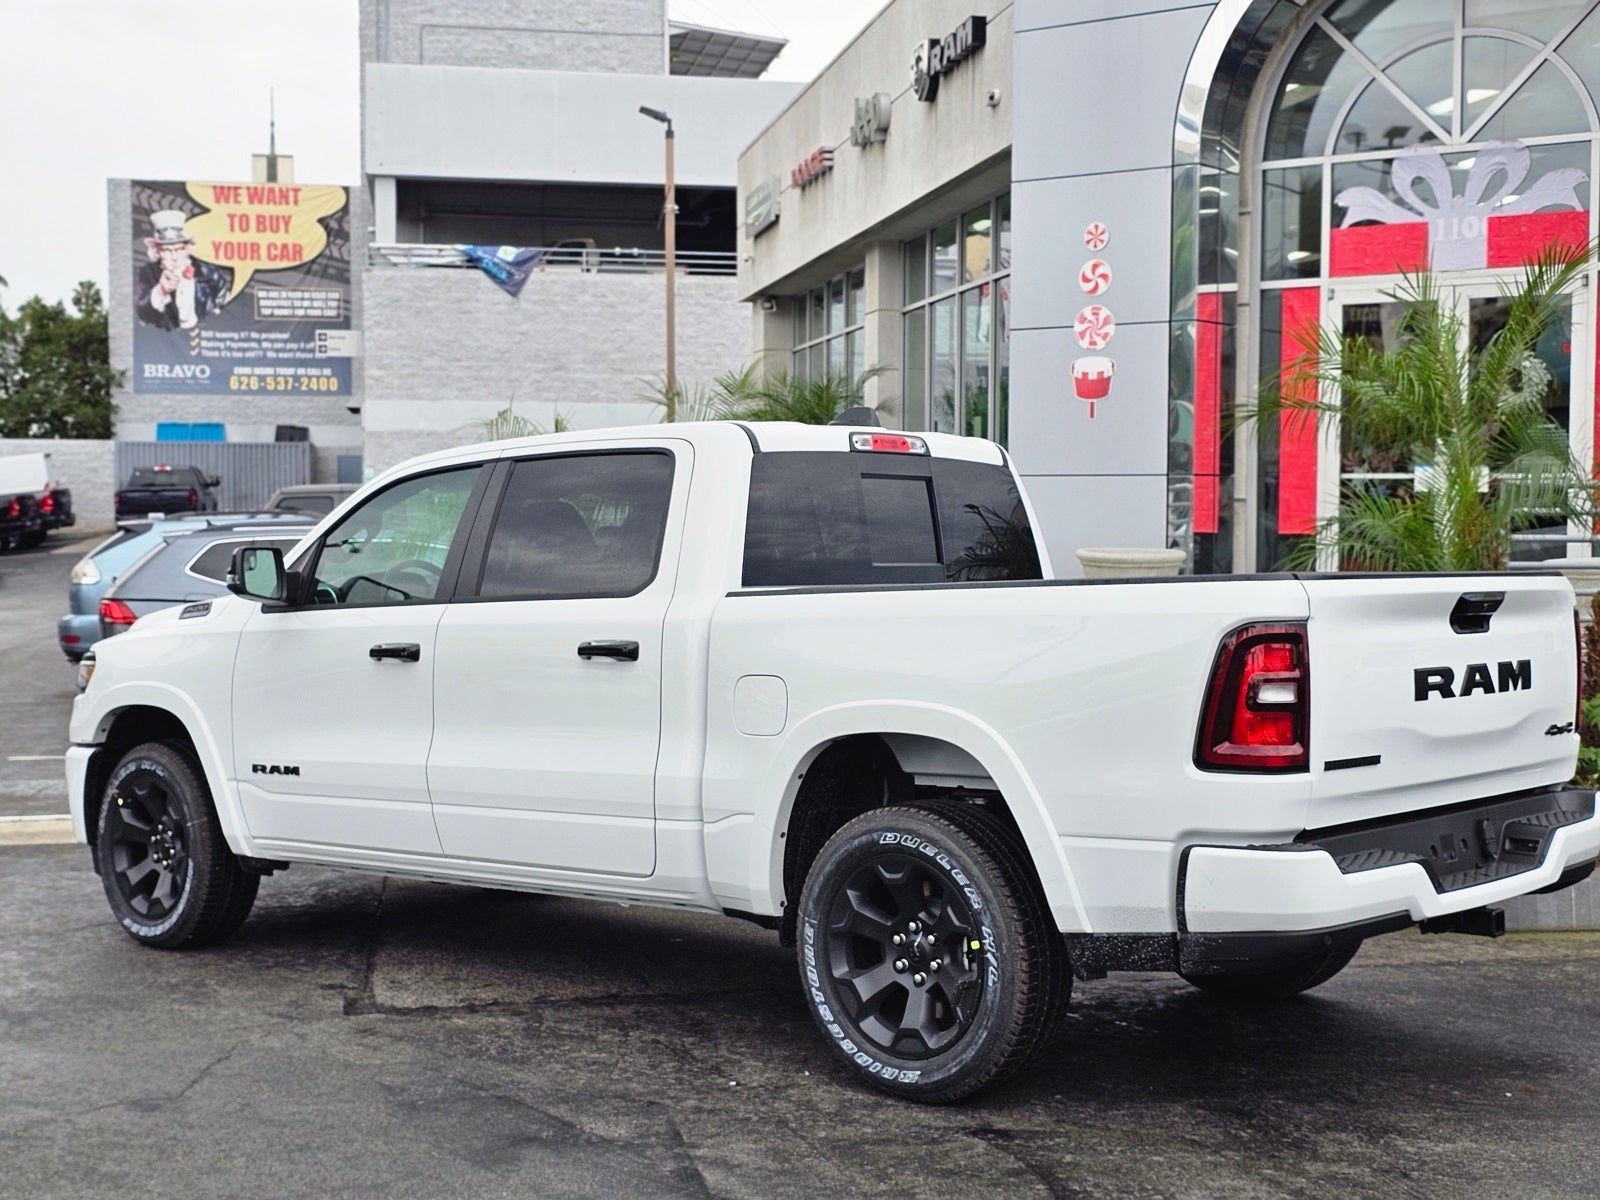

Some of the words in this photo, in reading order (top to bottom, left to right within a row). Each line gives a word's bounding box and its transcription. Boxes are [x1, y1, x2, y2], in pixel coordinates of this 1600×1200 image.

[930, 16, 978, 76] RAM
[212, 186, 242, 204] WE
[246, 187, 301, 206] WANT
[227, 213, 250, 233] TO
[256, 214, 292, 234] BUY
[211, 241, 261, 261] YOUR
[266, 242, 304, 262] CAR
[143, 364, 211, 379] BRAVO
[230, 375, 338, 392] 626-537-2400
[1414, 659, 1532, 702] RAM
[252, 763, 300, 777] RAM
[879, 831, 982, 909] DUELER
[803, 919, 921, 1084] BRIDGESTONE
